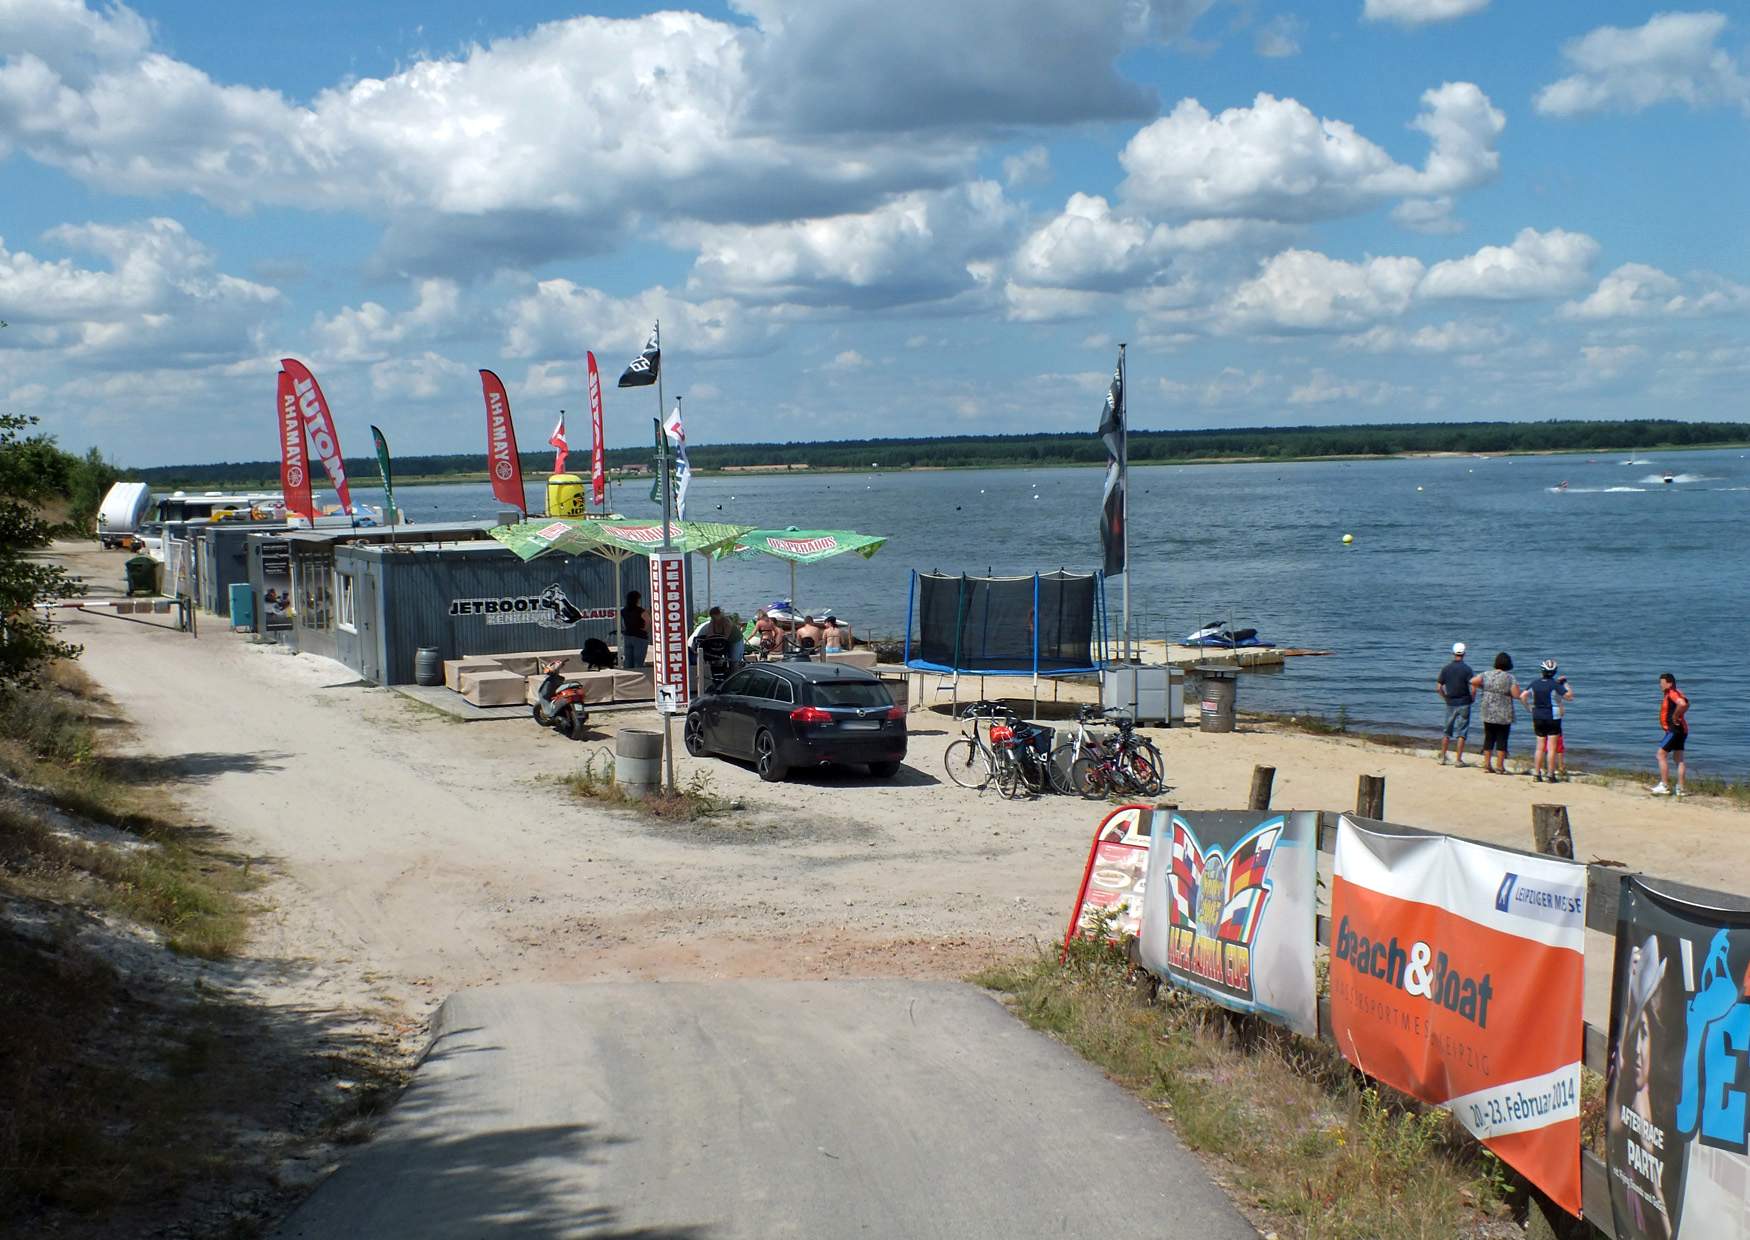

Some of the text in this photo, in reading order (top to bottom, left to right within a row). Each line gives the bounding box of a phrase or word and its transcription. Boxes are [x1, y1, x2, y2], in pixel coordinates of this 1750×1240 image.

[768, 536, 836, 554] DESPERADOS
[450, 598, 540, 615] JETBOOT
[1515, 887, 1553, 909] LEIPZIGER
[1225, 942, 1249, 993] CUP
[1505, 1091, 1551, 1122] Februar
[1621, 1104, 1665, 1151] AFTER RACE
[1627, 1138, 1665, 1189] PARTY
